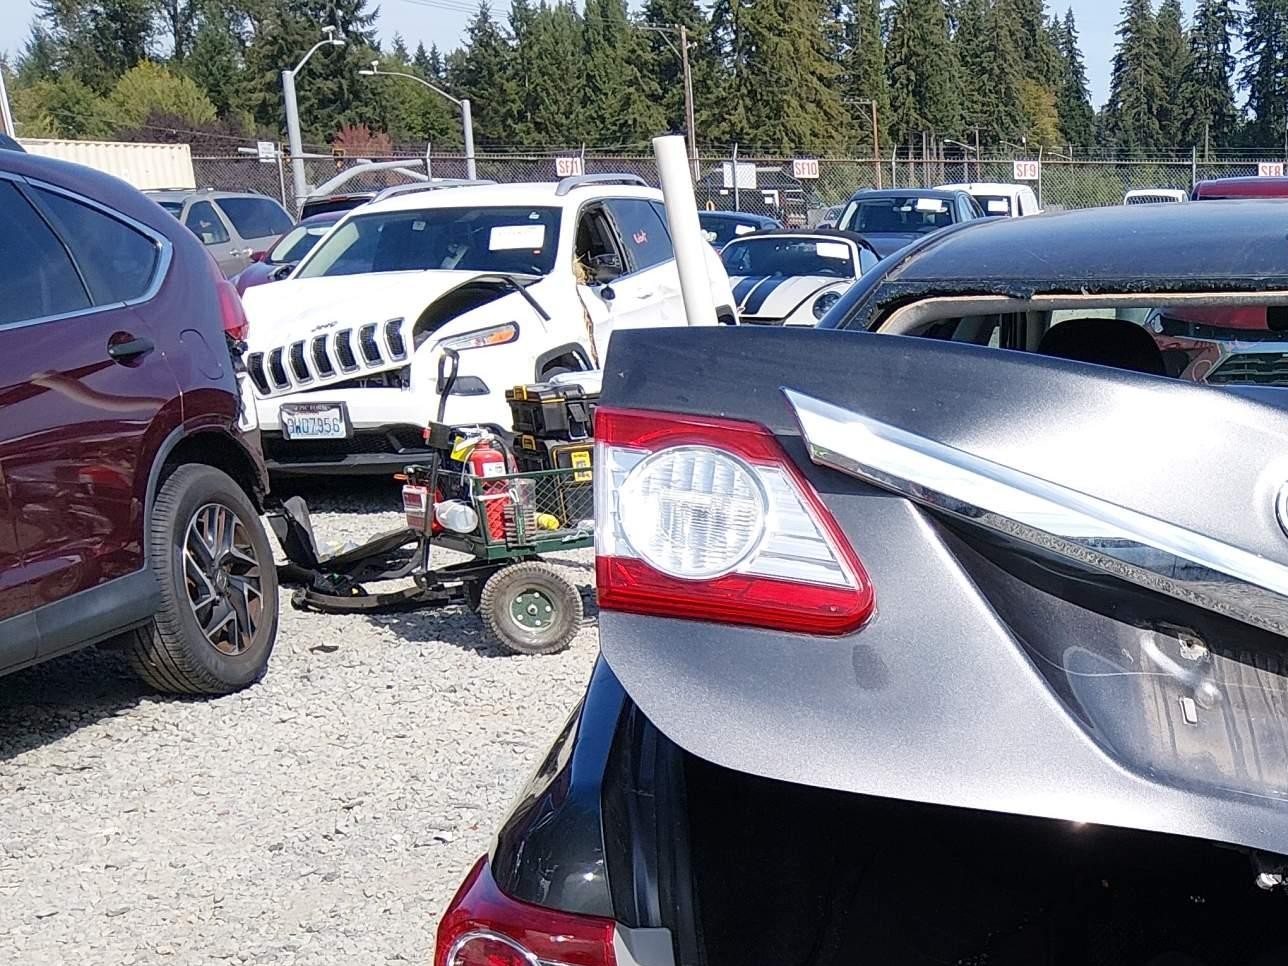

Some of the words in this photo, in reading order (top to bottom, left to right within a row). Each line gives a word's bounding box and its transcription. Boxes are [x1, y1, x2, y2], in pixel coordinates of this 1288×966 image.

[794, 161, 818, 176] SF10
[1016, 163, 1037, 177] SF9
[1261, 165, 1281, 176] SF8
